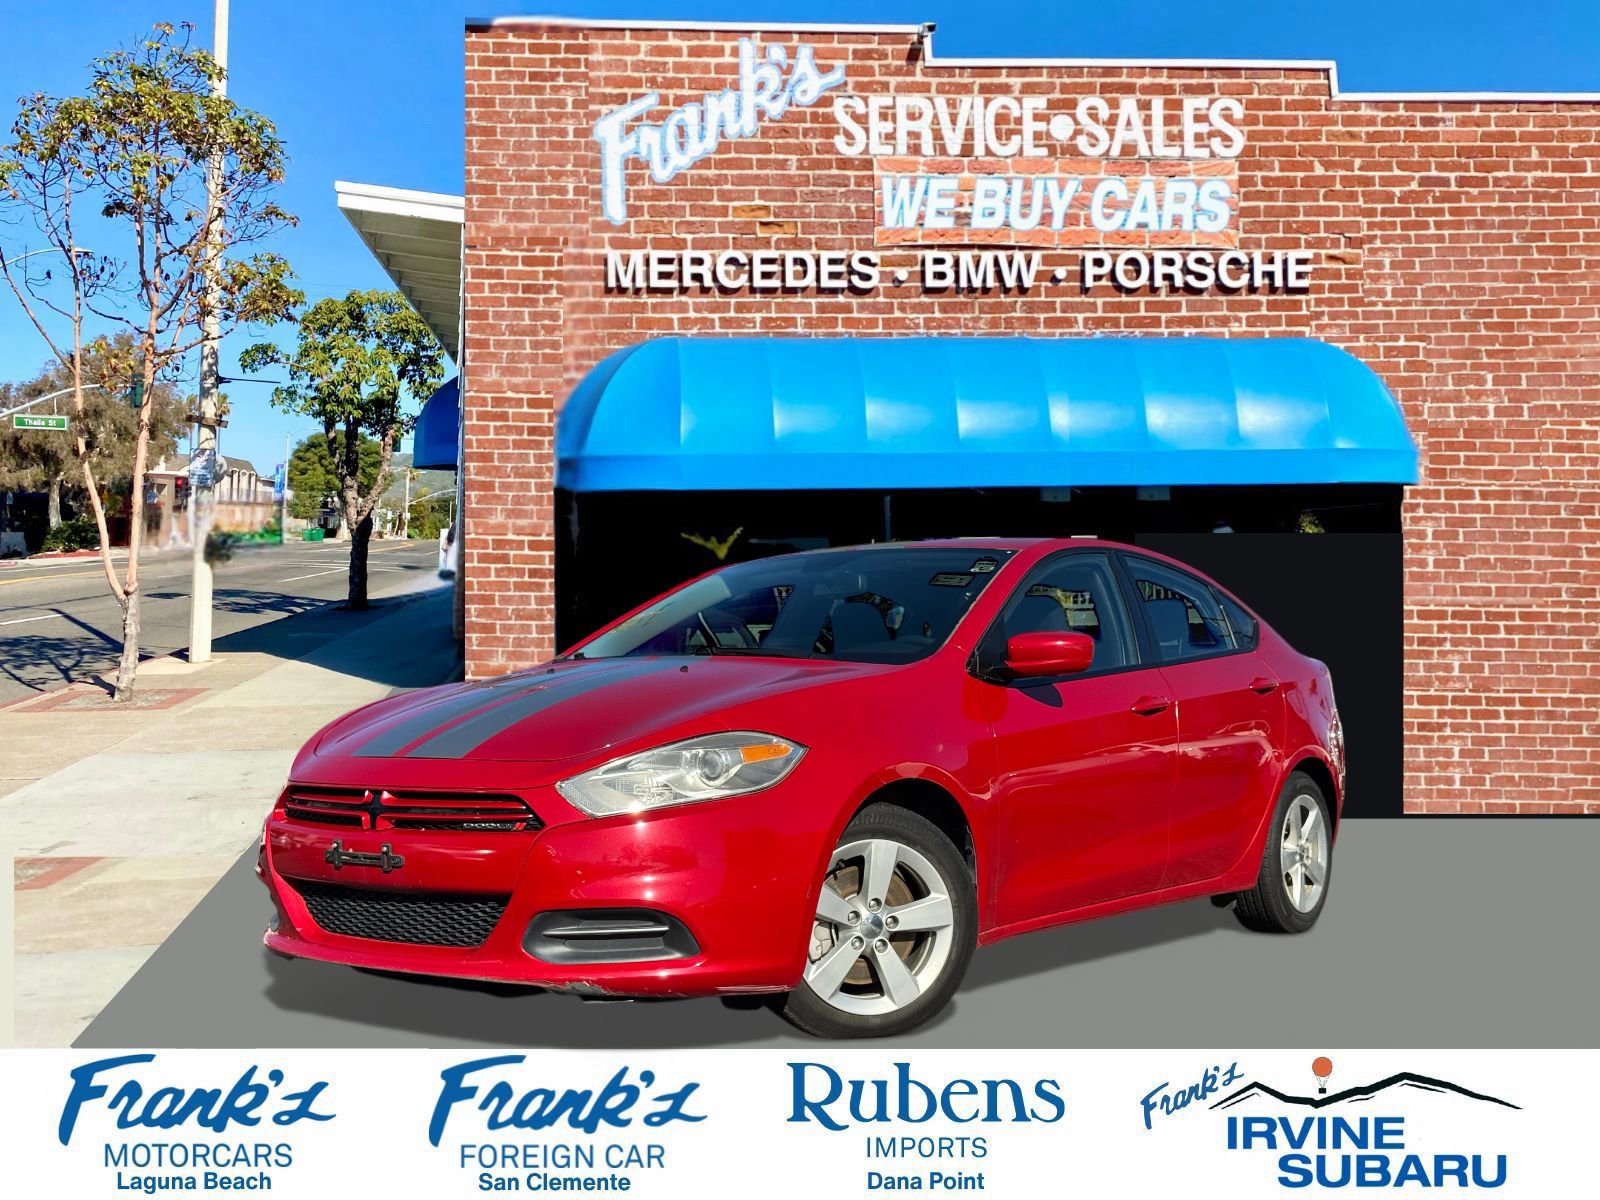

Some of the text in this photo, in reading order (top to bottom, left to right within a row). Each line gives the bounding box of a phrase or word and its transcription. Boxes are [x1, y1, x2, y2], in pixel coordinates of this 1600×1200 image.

[594, 38, 846, 225] Frank's
[881, 175, 1233, 233] WE BUY CARS
[606, 251, 1313, 290] MERCEDES BMW PORSCHE
[48, 419, 57, 427] St
